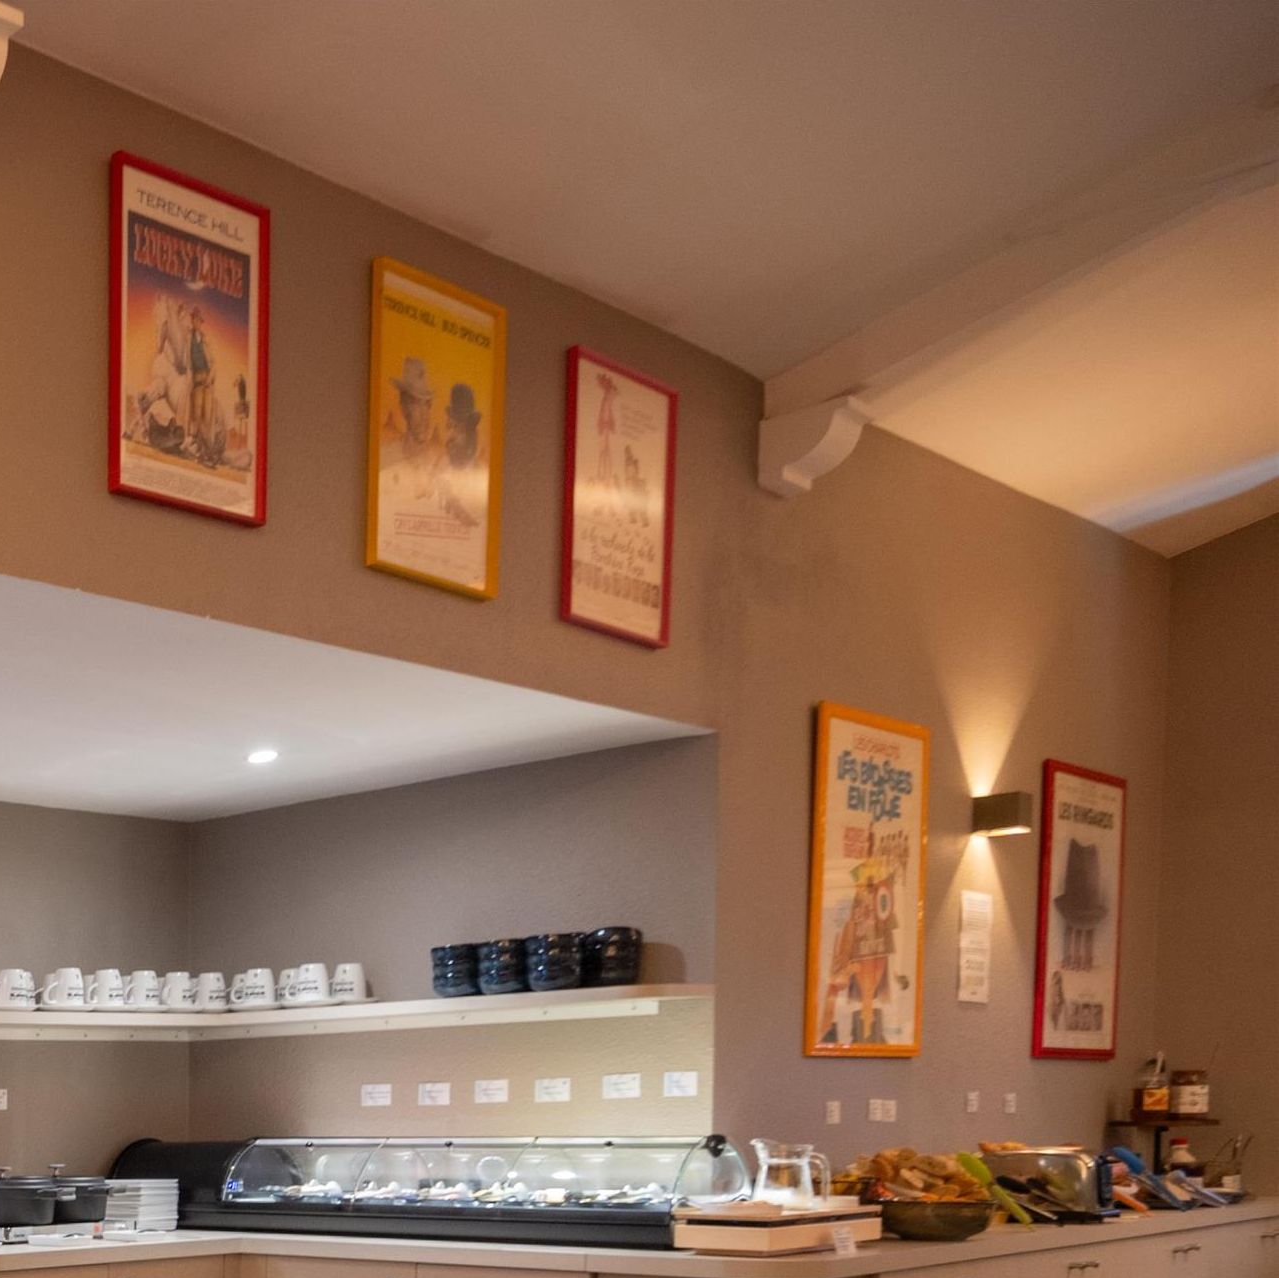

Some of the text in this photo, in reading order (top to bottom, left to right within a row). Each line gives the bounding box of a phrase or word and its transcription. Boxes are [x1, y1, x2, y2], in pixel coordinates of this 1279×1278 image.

[136, 188, 245, 242] TERENCE HILL
[132, 223, 244, 299] LUCKY LUKE
[847, 784, 867, 813] EN
